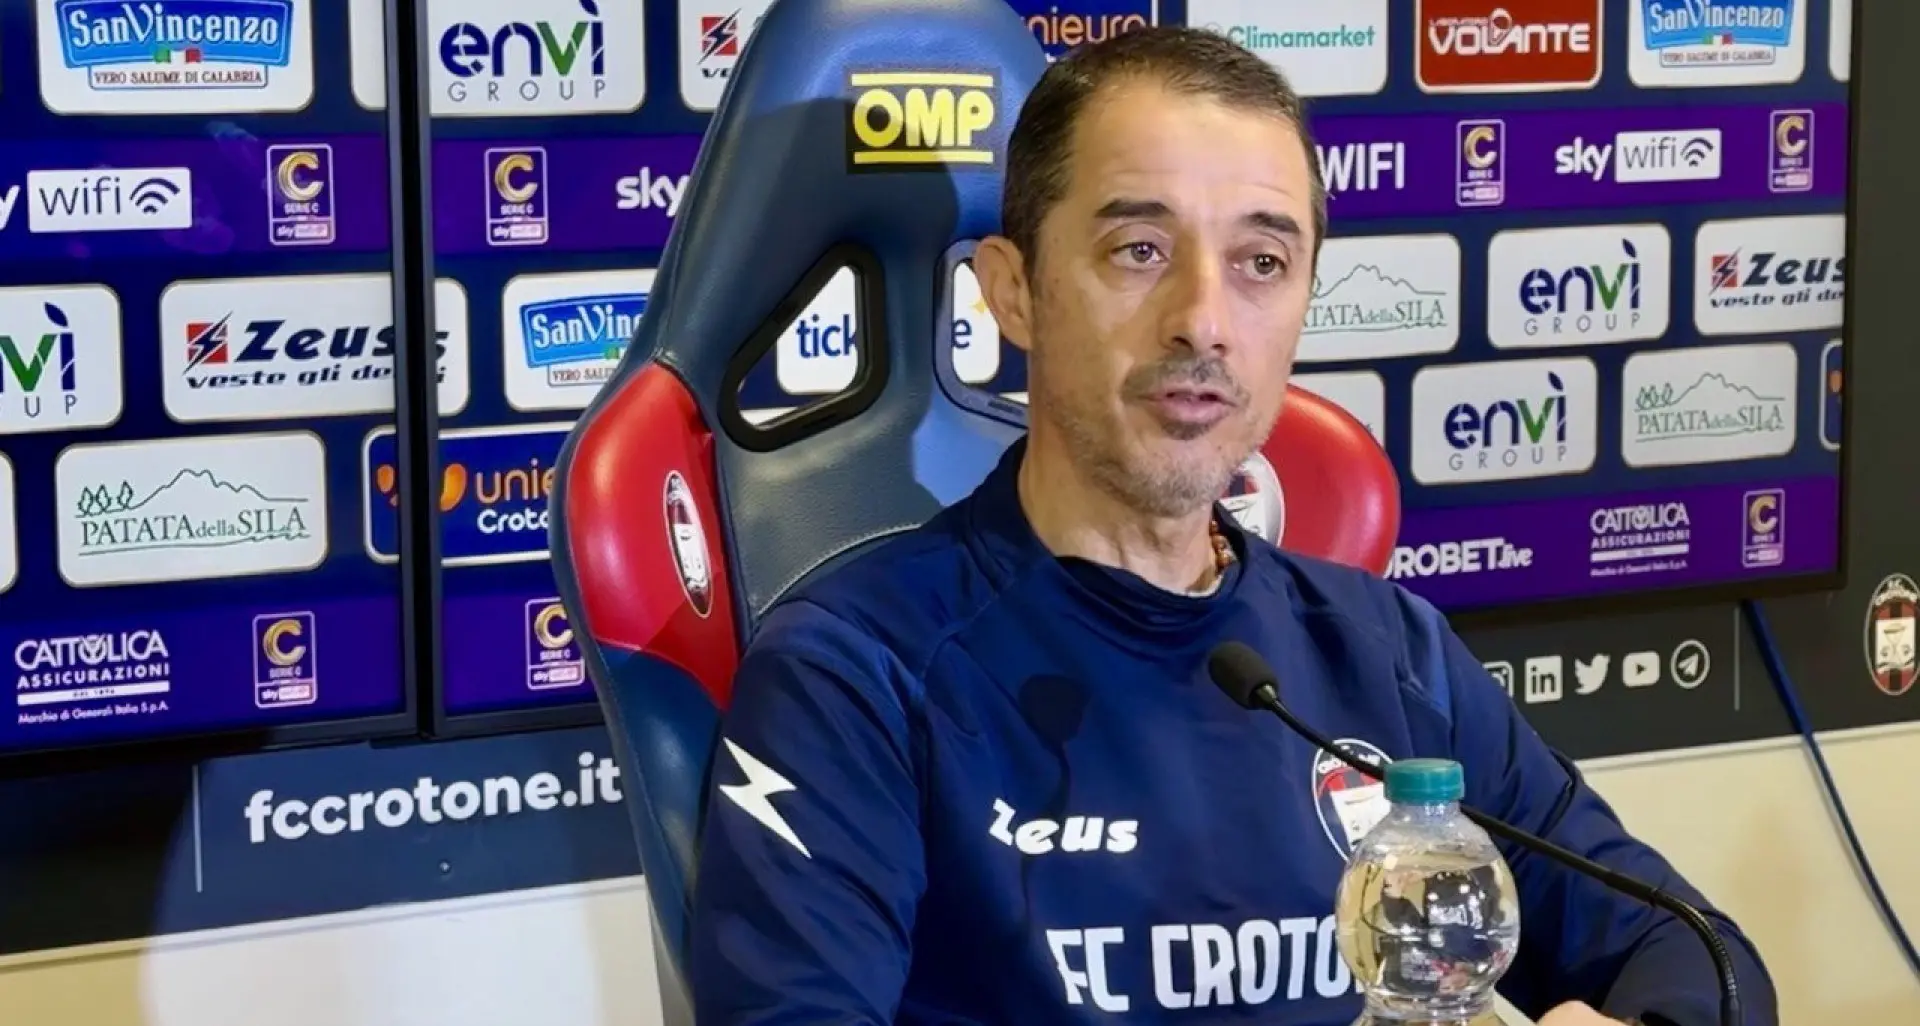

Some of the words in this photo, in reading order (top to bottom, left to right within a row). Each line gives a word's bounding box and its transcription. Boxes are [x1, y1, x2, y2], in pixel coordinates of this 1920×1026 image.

[69, 2, 278, 48] SanVincenzo
[1020, 6, 1147, 46] nieur
[1226, 24, 1375, 49] Climamarket
[1650, 0, 1785, 33] SanVincenzo
[1428, 22, 1591, 55] VOLANTE
[93, 71, 127, 84] VERO
[131, 71, 180, 84] SALUME
[185, 71, 198, 83] DI
[202, 71, 263, 84] CALABRIA
[447, 79, 606, 102] GROUP
[853, 88, 994, 148] OMP
[1315, 142, 1405, 193] WIFI
[1554, 137, 1613, 181] sky
[1623, 137, 1677, 169] wifi
[38, 176, 121, 216] wifi
[615, 165, 691, 218] sky
[1523, 312, 1641, 336] GROUP
[186, 370, 286, 389] veste
[296, 363, 342, 386] gli
[1448, 445, 1567, 471] GROUP
[1590, 502, 1691, 535] CATTOLICA
[14, 628, 169, 671] CATTOLICA
[17, 661, 170, 690] ASSICURAZIONI
[245, 751, 623, 843] fccrotone.it
[988, 798, 1138, 855] Zeus
[1045, 926, 1130, 1013] FC
[1151, 914, 1366, 1013] CROTO
